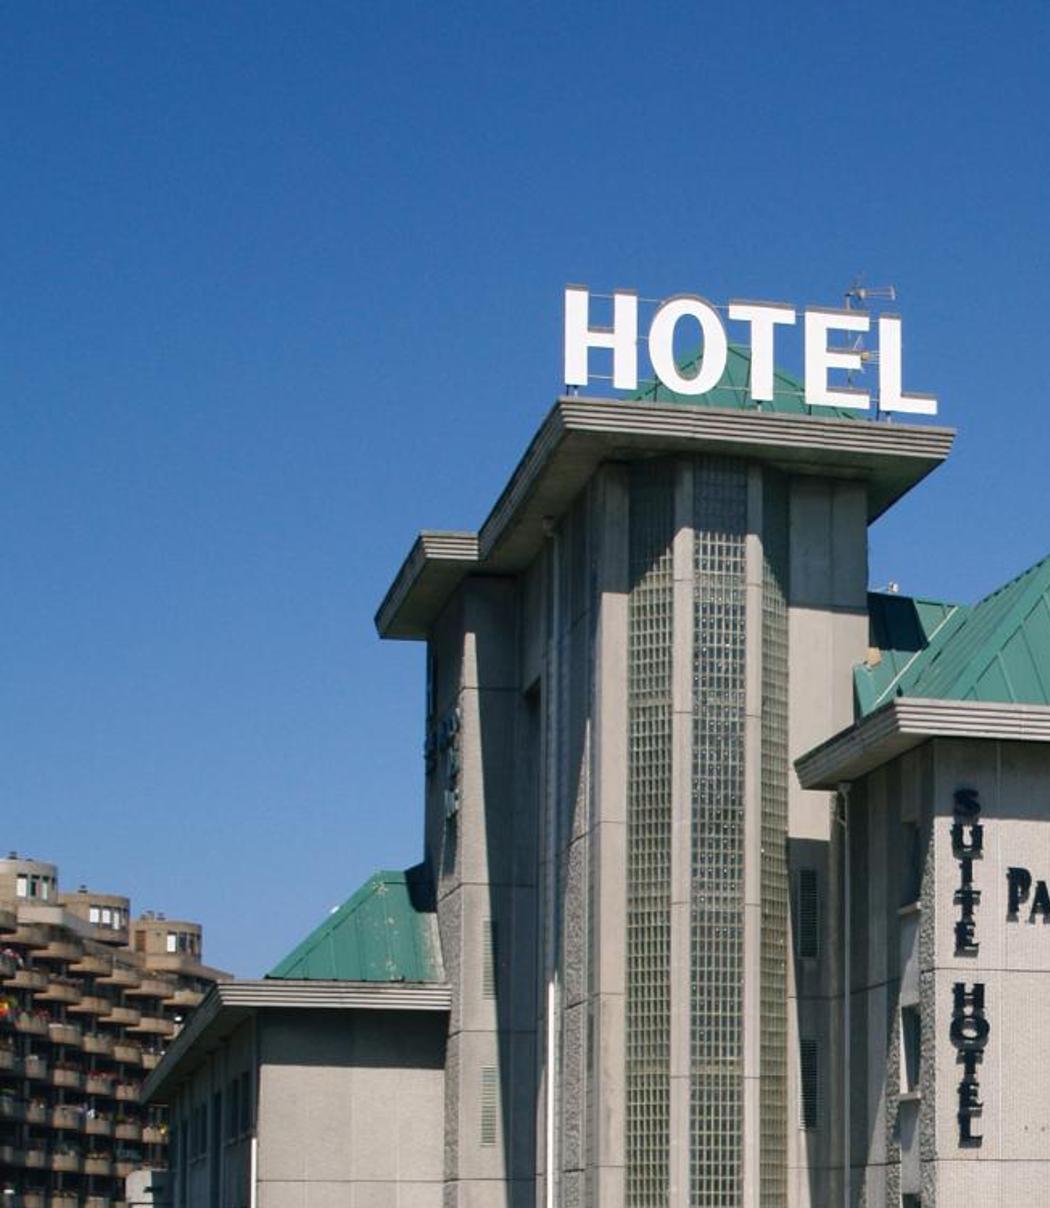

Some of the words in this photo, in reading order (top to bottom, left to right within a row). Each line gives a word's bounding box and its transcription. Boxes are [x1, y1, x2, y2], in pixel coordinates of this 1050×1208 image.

[564, 284, 938, 415] HOTEL
[951, 787, 984, 958] SUITE
[949, 982, 991, 1148] HOTEL
